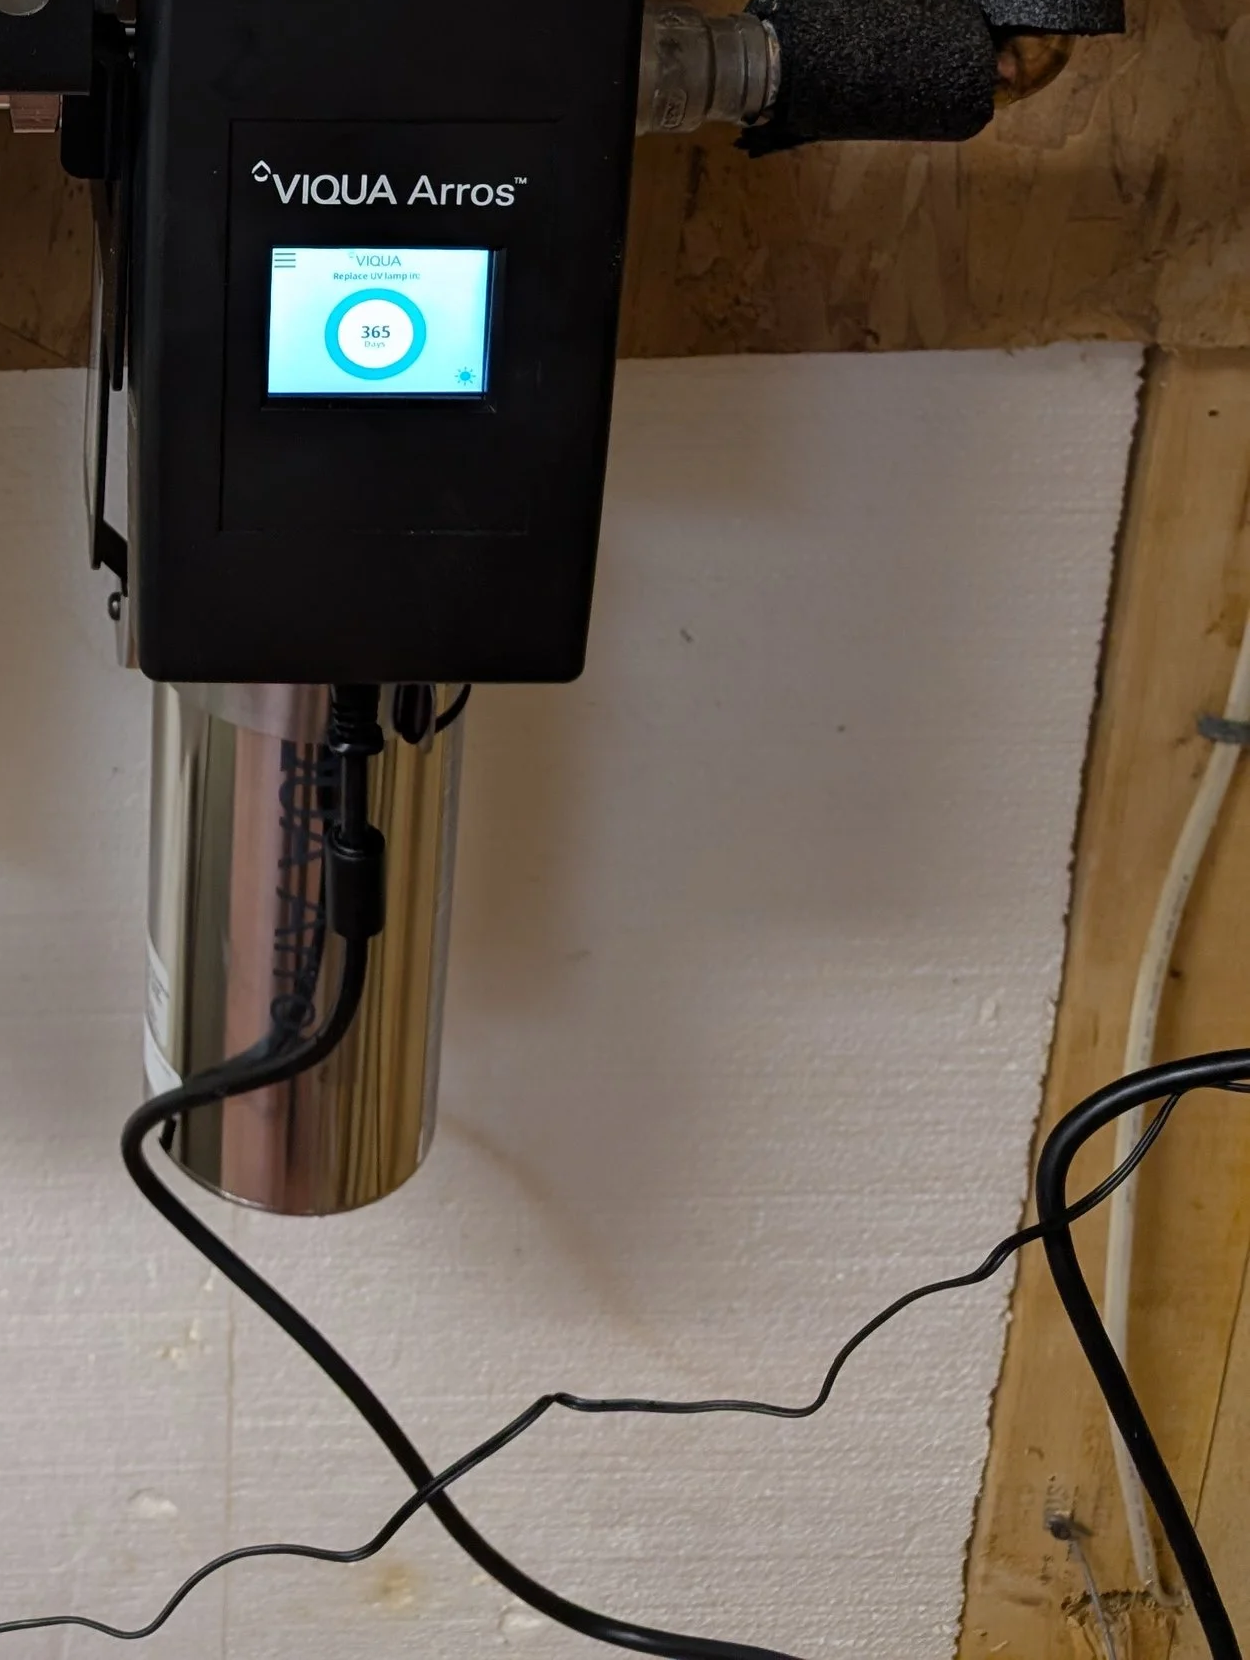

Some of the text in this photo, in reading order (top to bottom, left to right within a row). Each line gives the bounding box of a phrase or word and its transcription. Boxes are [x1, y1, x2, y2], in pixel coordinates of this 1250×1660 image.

[272, 174, 398, 205] VIQUA
[356, 255, 401, 267] VIQUA
[333, 272, 368, 281] Replace
[370, 272, 383, 280] UV
[384, 272, 408, 281] lamp
[361, 325, 390, 339] 365
[364, 340, 385, 348] Days
